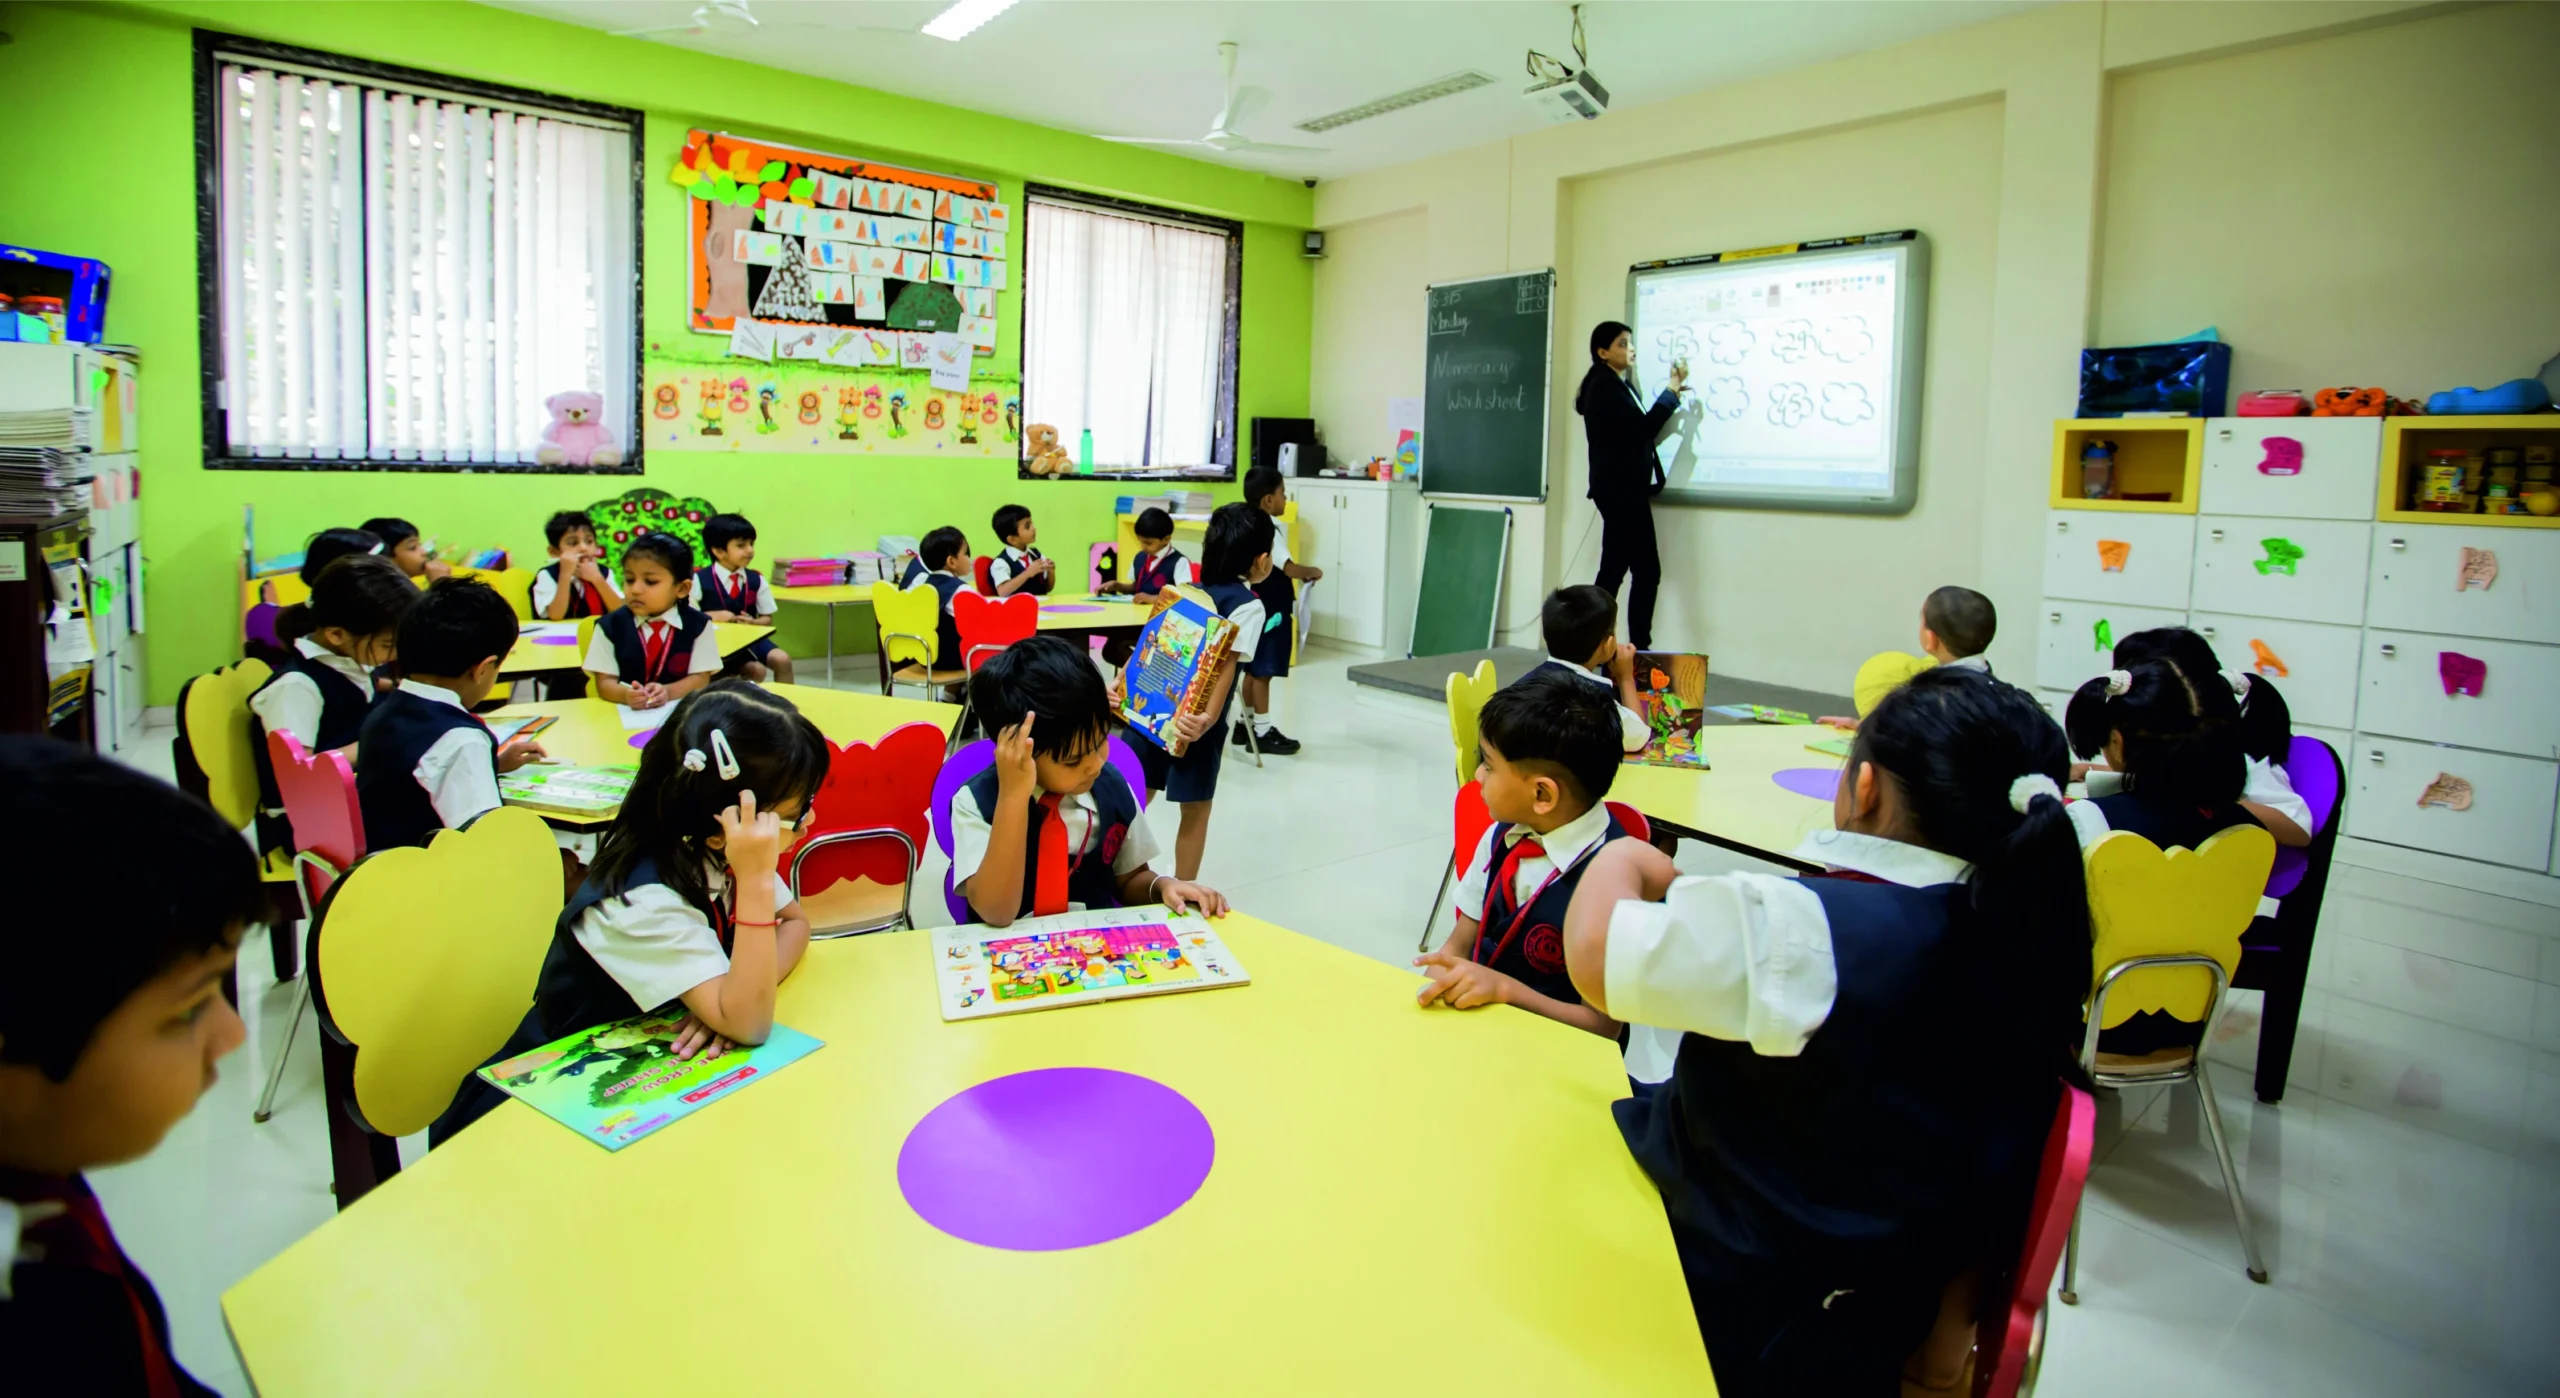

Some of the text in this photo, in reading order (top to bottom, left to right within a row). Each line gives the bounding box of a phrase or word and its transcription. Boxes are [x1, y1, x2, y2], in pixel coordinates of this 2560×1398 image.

[1430, 311, 1471, 337] Monday
[1433, 351, 1515, 383] Numeracy
[1447, 384, 1528, 411] Worksheet
[603, 1067, 662, 1097] SHEEP
[642, 1066, 692, 1092] CROW
